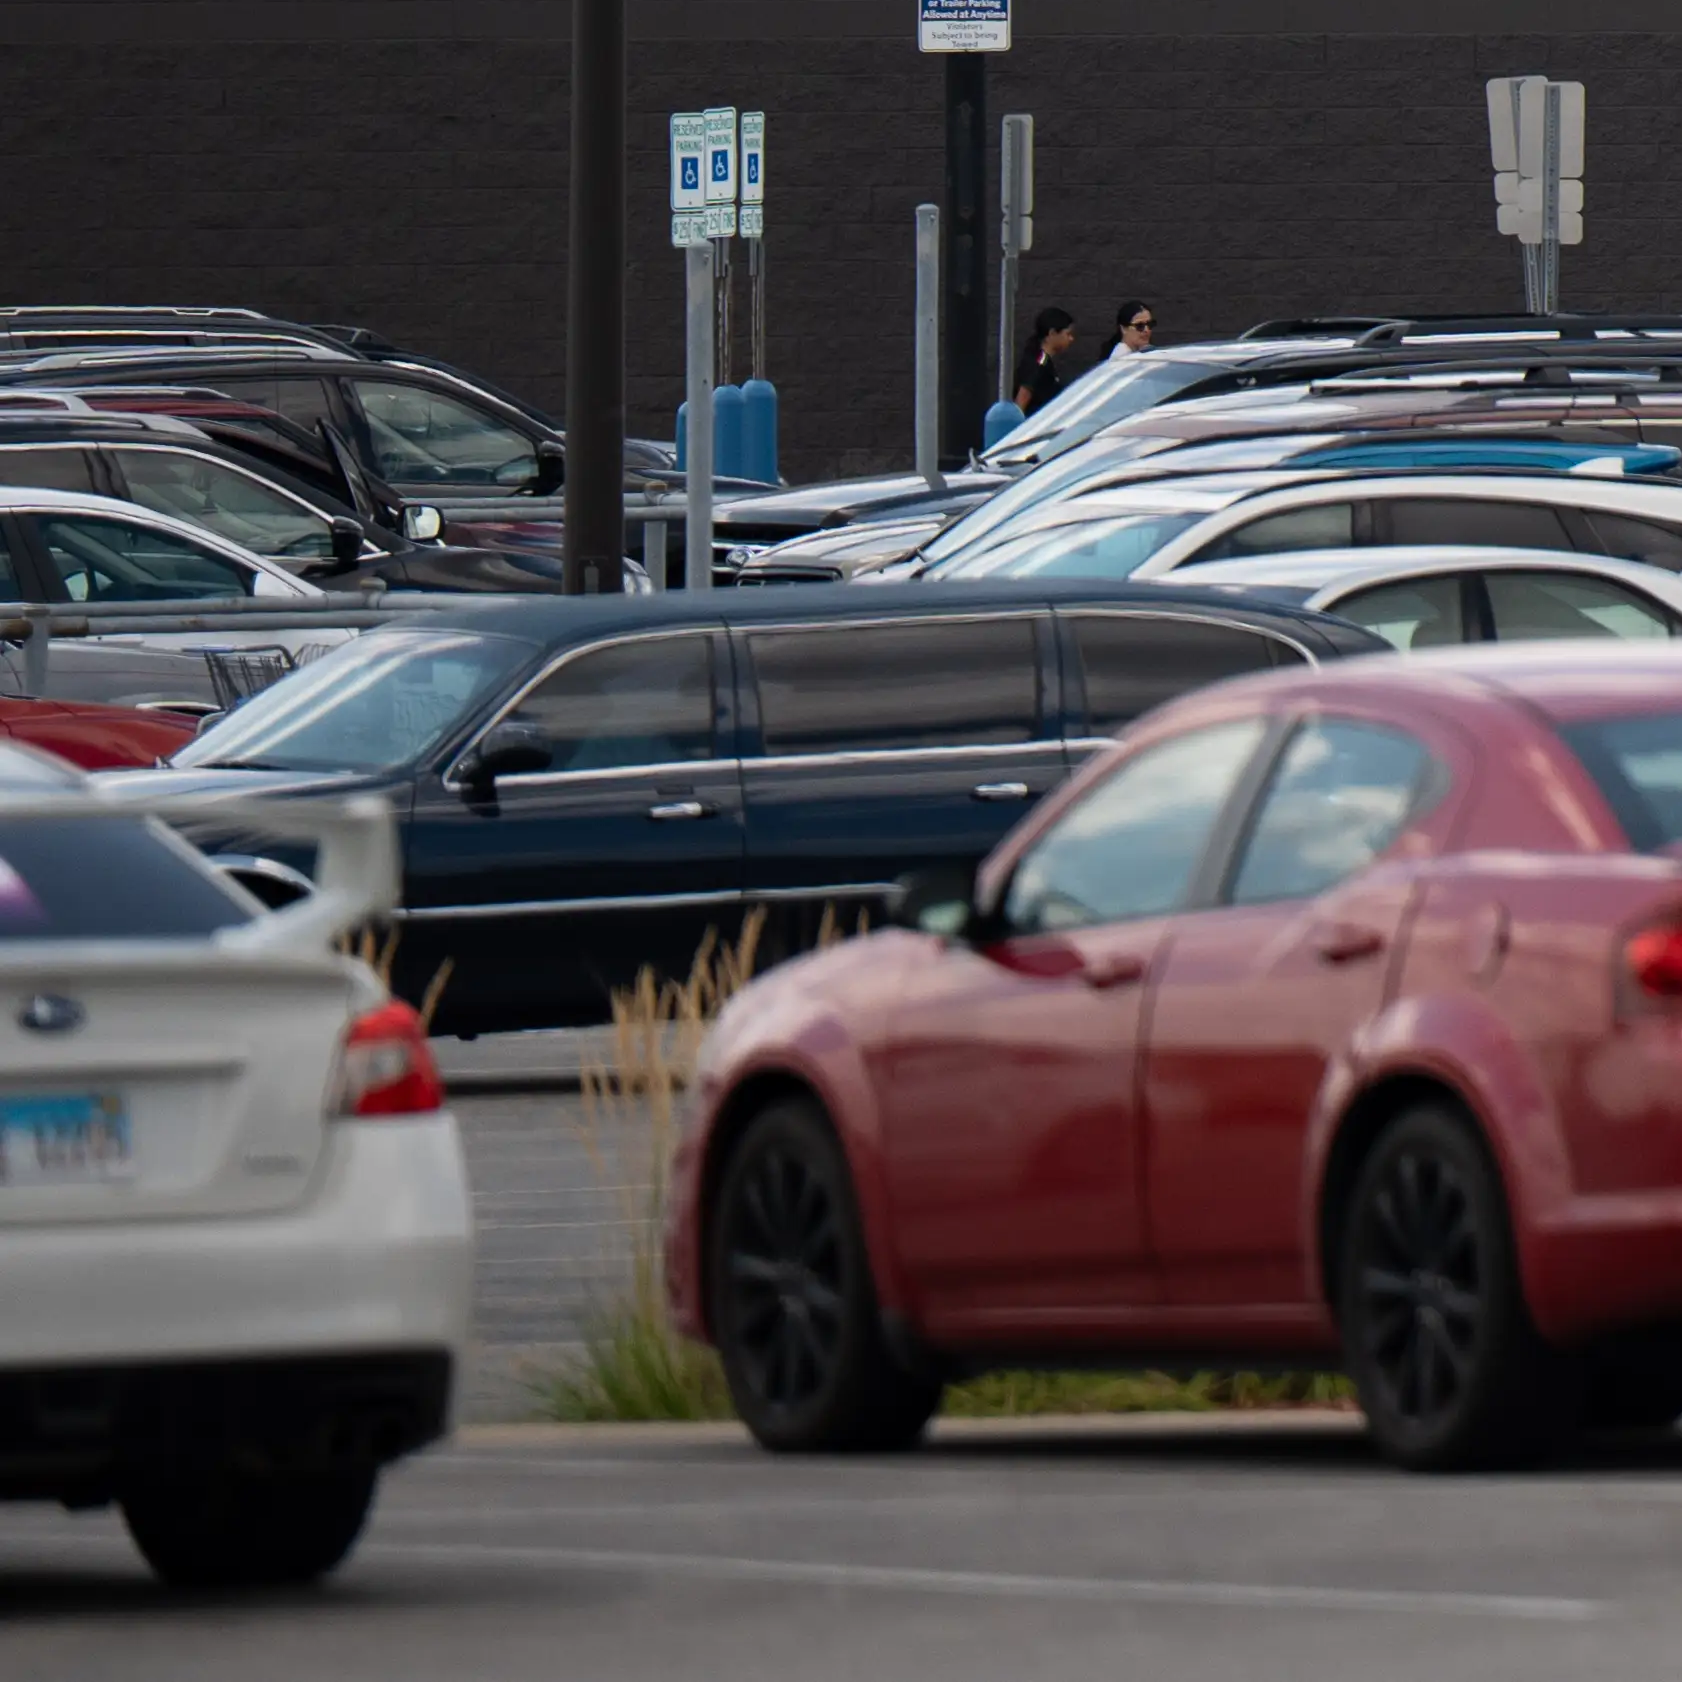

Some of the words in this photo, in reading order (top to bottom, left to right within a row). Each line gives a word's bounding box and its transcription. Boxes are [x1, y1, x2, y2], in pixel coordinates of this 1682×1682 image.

[968, 0, 1001, 9] Parking
[922, 10, 958, 19] Allowed
[959, 10, 969, 19] at
[970, 10, 1006, 20] Anytime
[931, 31, 963, 41] Subject
